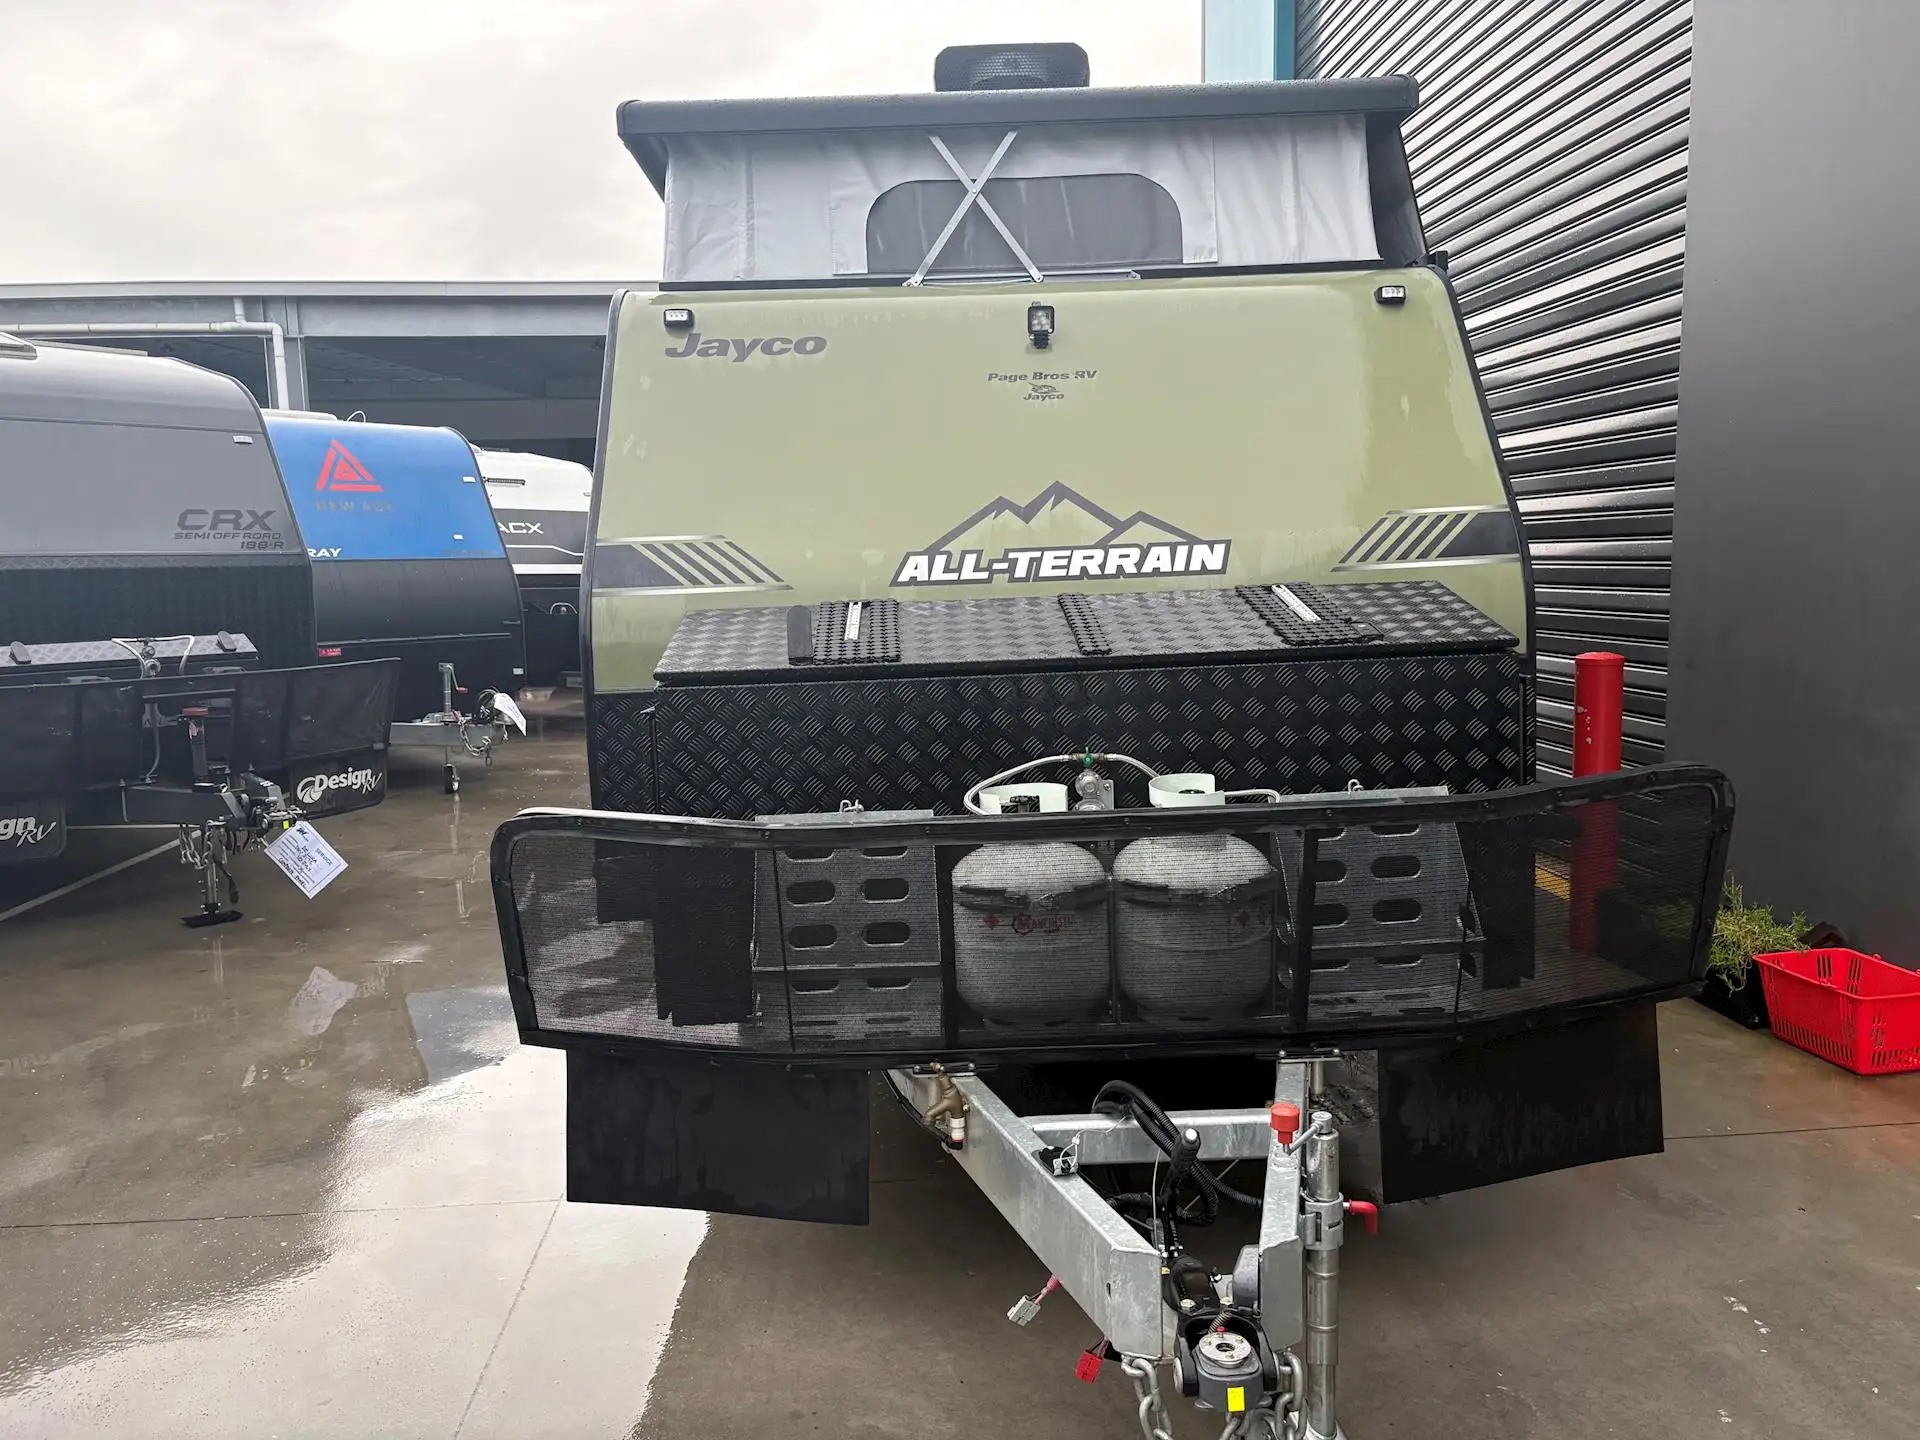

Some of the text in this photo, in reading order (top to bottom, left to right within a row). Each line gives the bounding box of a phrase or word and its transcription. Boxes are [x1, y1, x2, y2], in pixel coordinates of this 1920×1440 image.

[665, 332, 828, 363] Jayco
[987, 370, 1098, 383] Page Bros RV
[1023, 392, 1065, 402] Jayco
[177, 508, 277, 531] CRX
[173, 532, 282, 540] SEMI OFF ROAD
[307, 547, 342, 558] RAY
[895, 542, 1228, 583] ALL-TERRAIN
[314, 766, 383, 795] Design RV
[16, 821, 57, 848] RV
